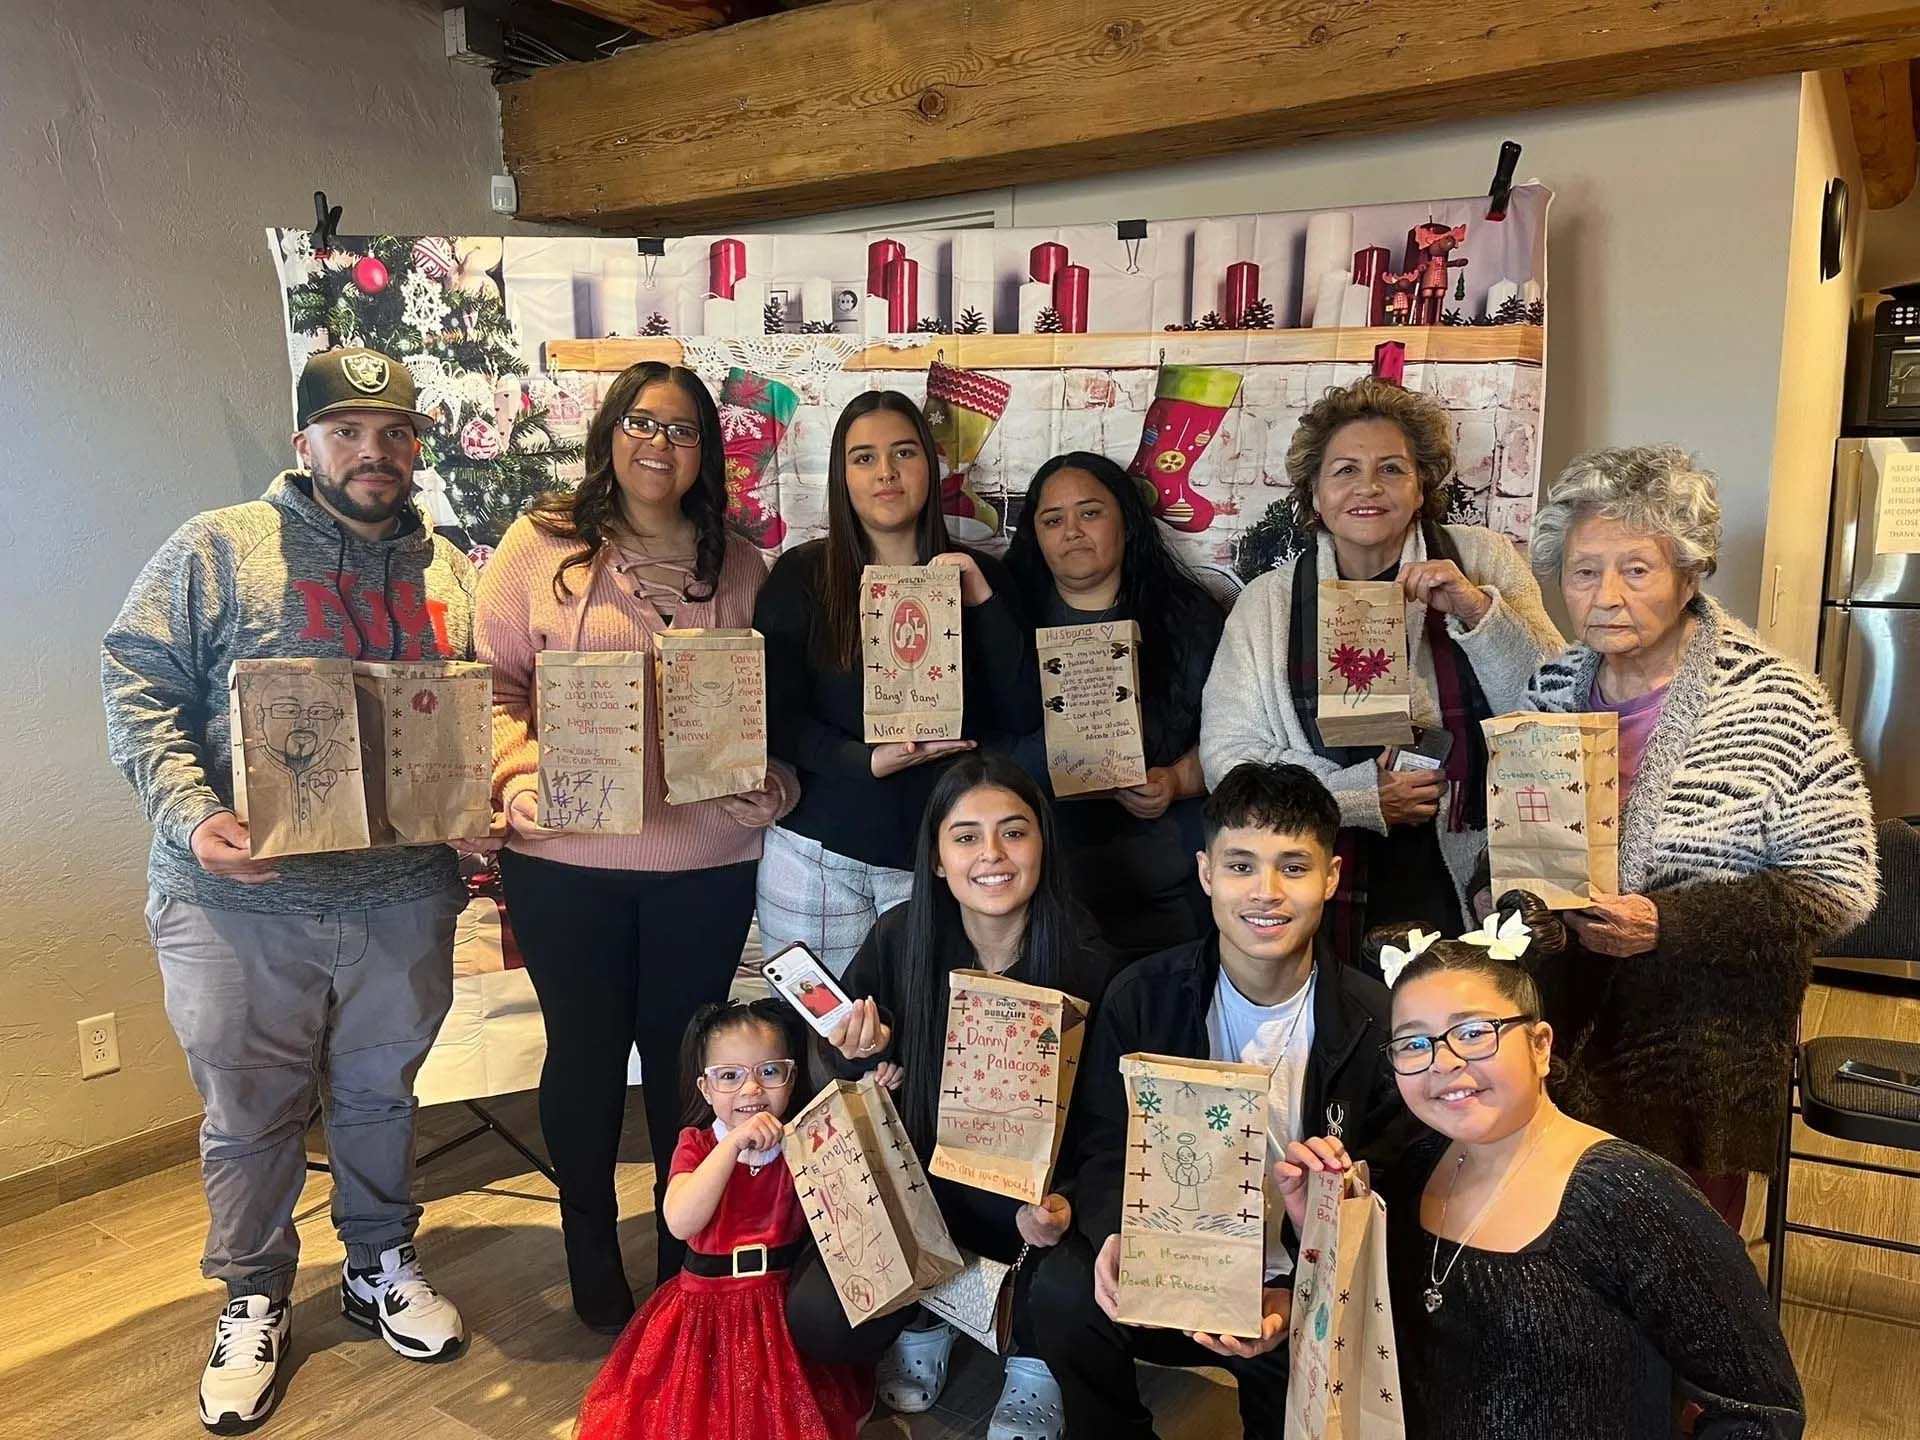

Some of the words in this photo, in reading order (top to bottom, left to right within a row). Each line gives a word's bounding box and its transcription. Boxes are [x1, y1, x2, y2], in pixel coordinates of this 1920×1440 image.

[591, 691, 614, 700] miss
[873, 723, 906, 738] Niner
[915, 723, 949, 738] Gang!
[967, 1026, 1010, 1053] Danny
[987, 1056, 1040, 1073] Palacios
[1123, 1235, 1146, 1259] In
